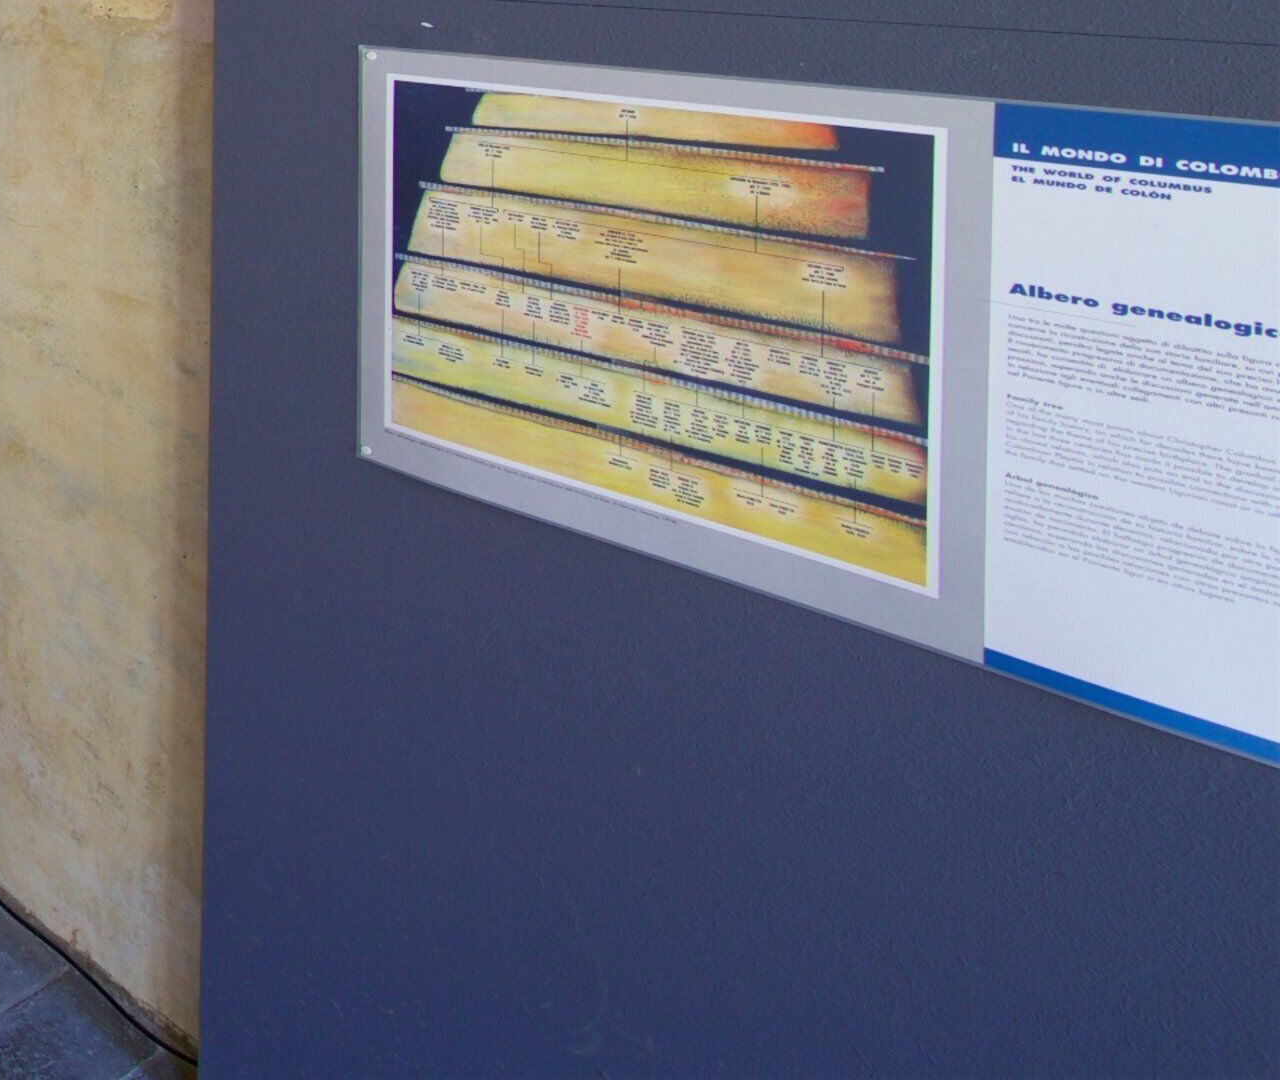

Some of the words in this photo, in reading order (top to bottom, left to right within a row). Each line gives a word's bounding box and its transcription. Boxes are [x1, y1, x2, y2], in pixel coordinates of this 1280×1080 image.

[1012, 142, 1030, 154] IL
[1041, 145, 1127, 164] MONDO
[1139, 155, 1163, 168] DI
[1175, 159, 1280, 180] COLOMB
[1011, 164, 1035, 174] THE
[1043, 167, 1095, 181] WORLD
[1102, 175, 1121, 183] OF
[1129, 177, 1212, 194] COLUMBUS
[1011, 175, 1025, 183] EL
[1032, 177, 1087, 190] MUNDO
[1094, 185, 1113, 194] DE
[1009, 282, 1100, 308] Albero
[1111, 301, 1279, 339] genealogic
